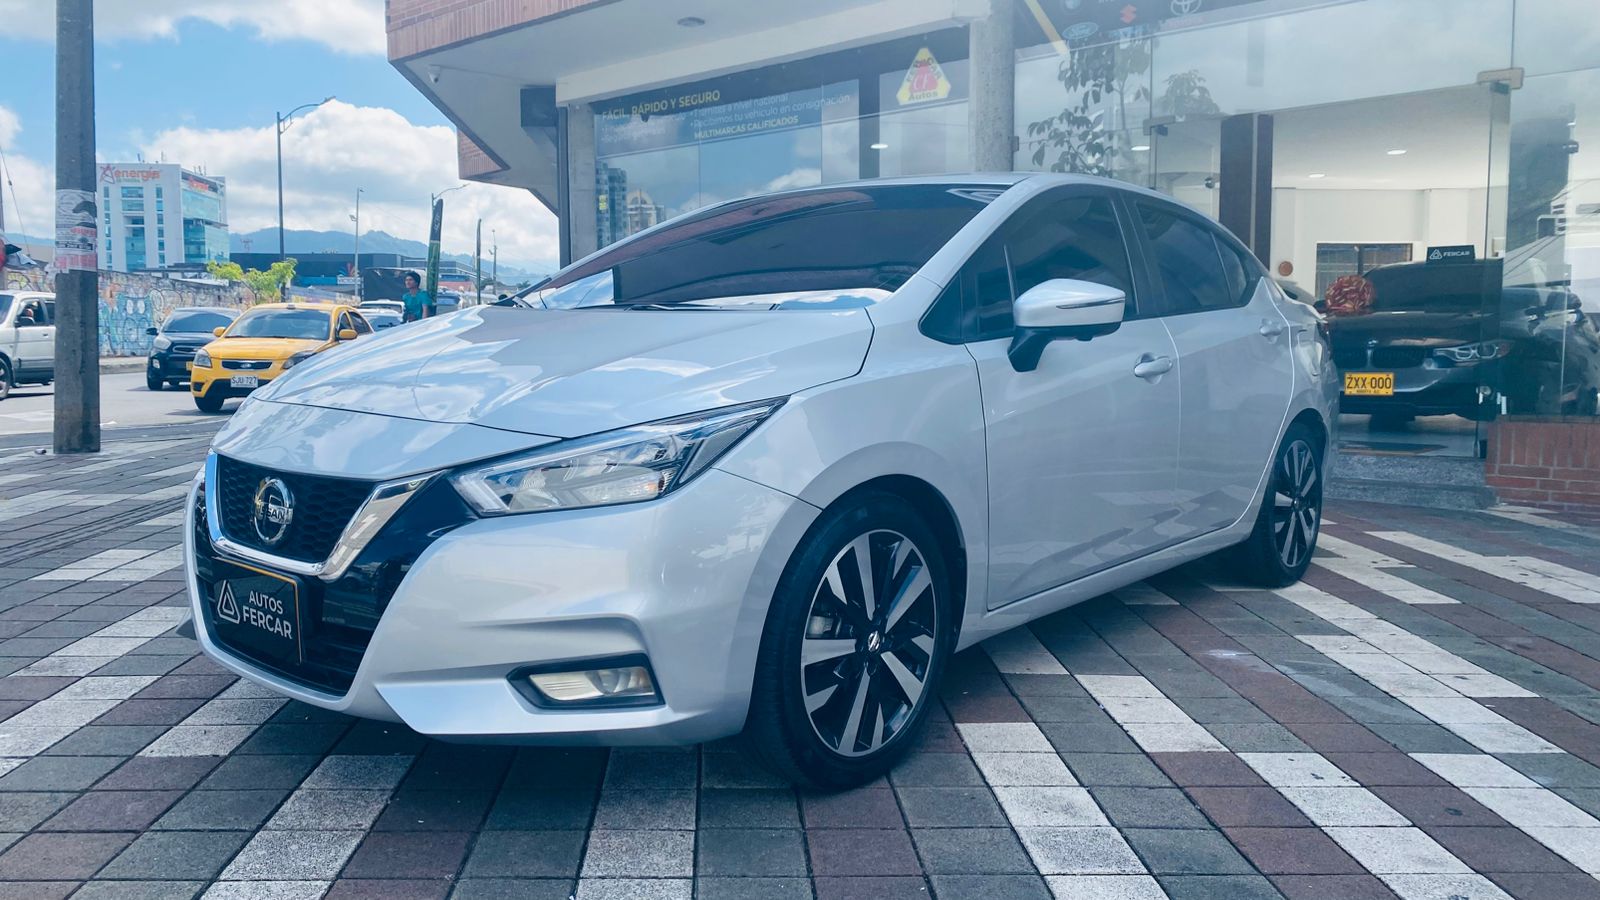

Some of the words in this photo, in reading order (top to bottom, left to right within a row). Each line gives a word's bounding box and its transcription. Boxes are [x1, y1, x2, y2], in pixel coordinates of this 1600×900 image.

[671, 99, 677, 109] Y
[679, 90, 720, 107] SEGURO
[753, 93, 789, 106] nacional
[908, 92, 938, 101] Autos
[734, 112, 743, 122] tu
[780, 104, 790, 114] en
[694, 124, 746, 139] MULTIMARCAS
[747, 115, 799, 130] CALIFICADOS
[249, 590, 284, 614] AUTOS
[242, 605, 293, 639] FERCAR
